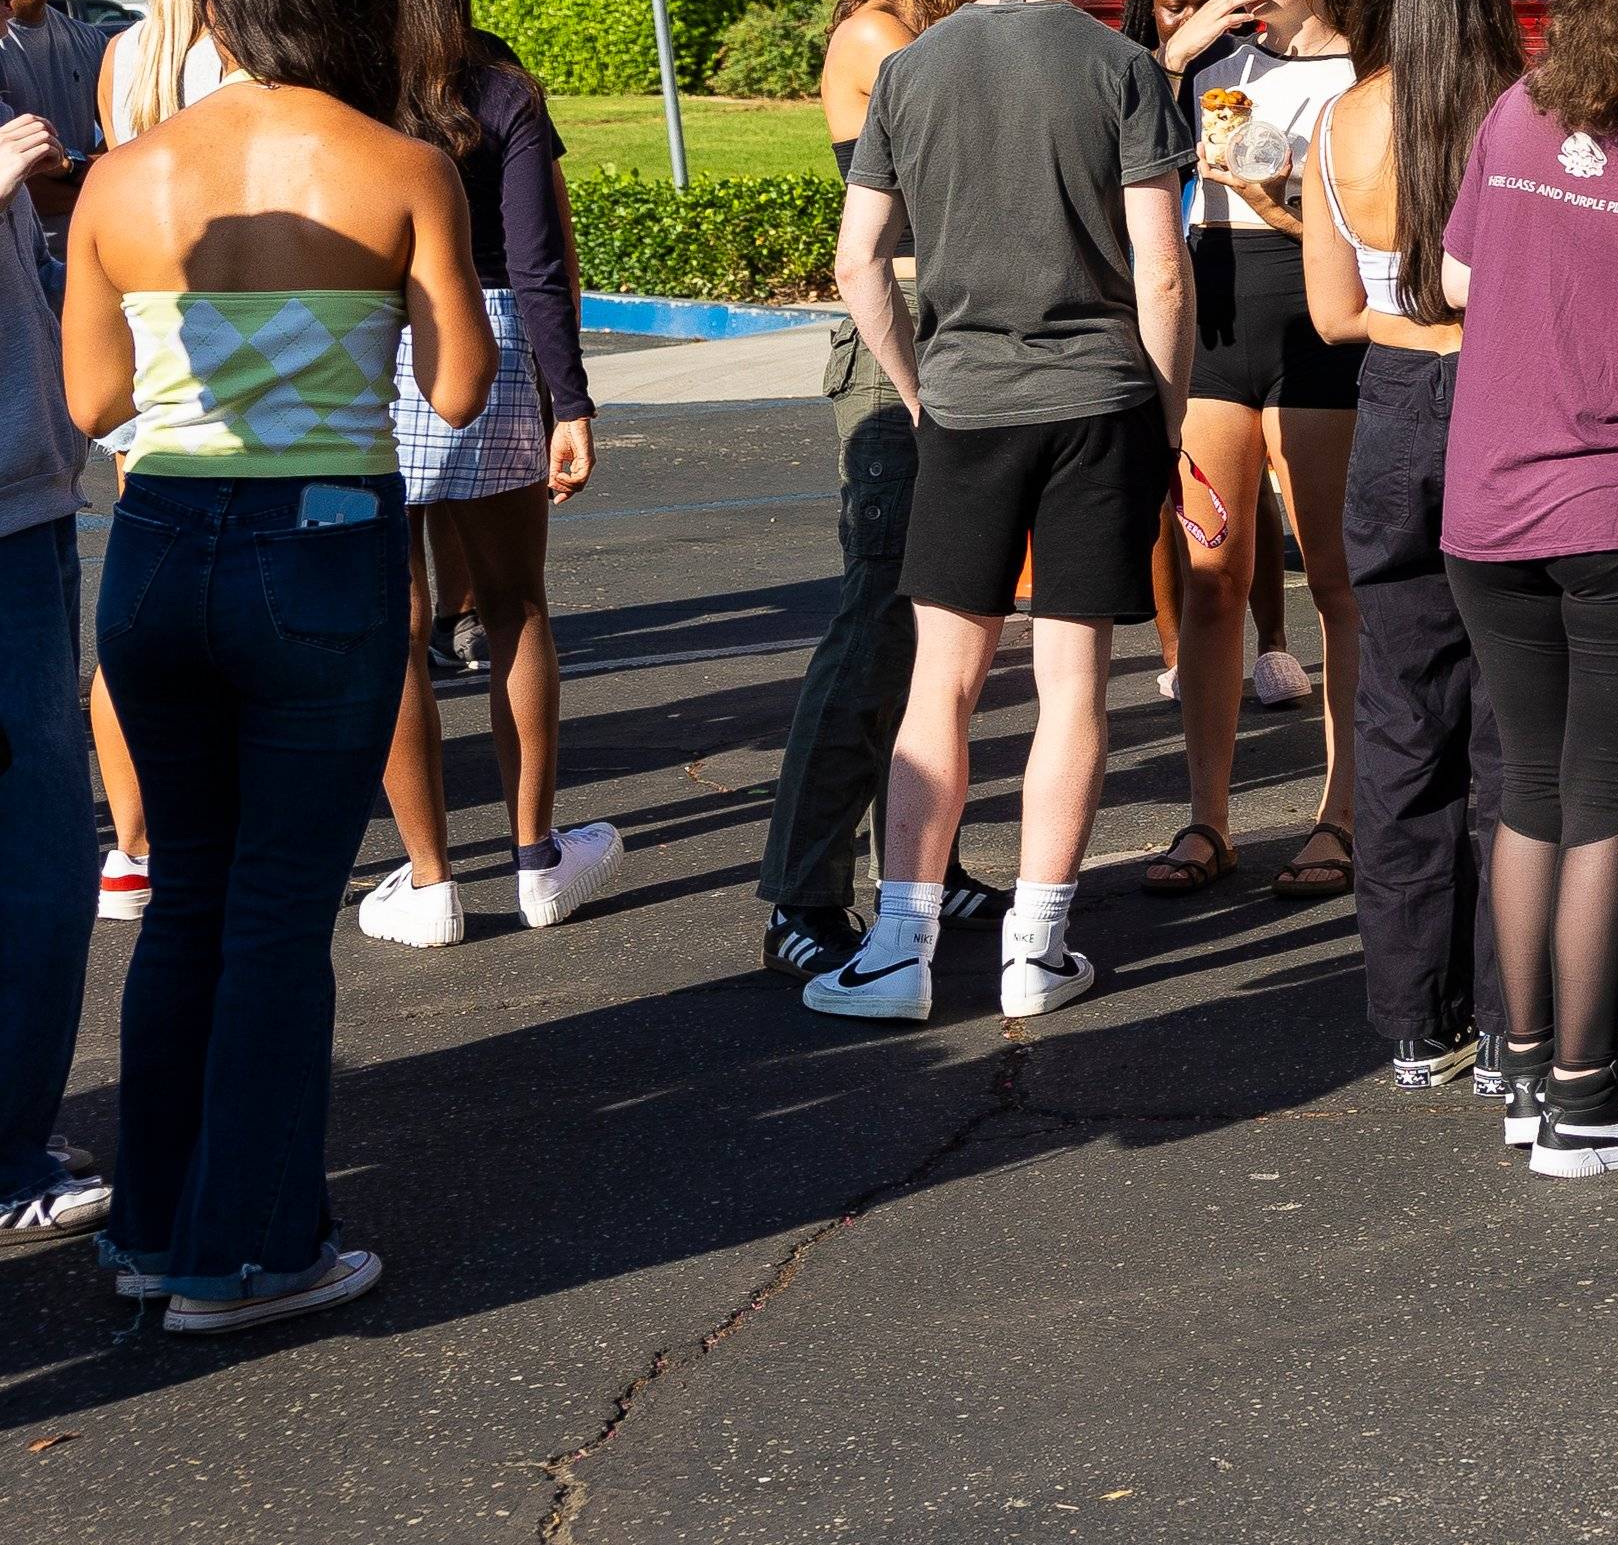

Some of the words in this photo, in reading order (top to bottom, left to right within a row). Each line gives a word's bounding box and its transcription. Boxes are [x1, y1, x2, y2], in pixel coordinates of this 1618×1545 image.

[1536, 183, 1563, 201] AND
[1564, 191, 1607, 212] PURPLE
[913, 933, 934, 945] NIKE
